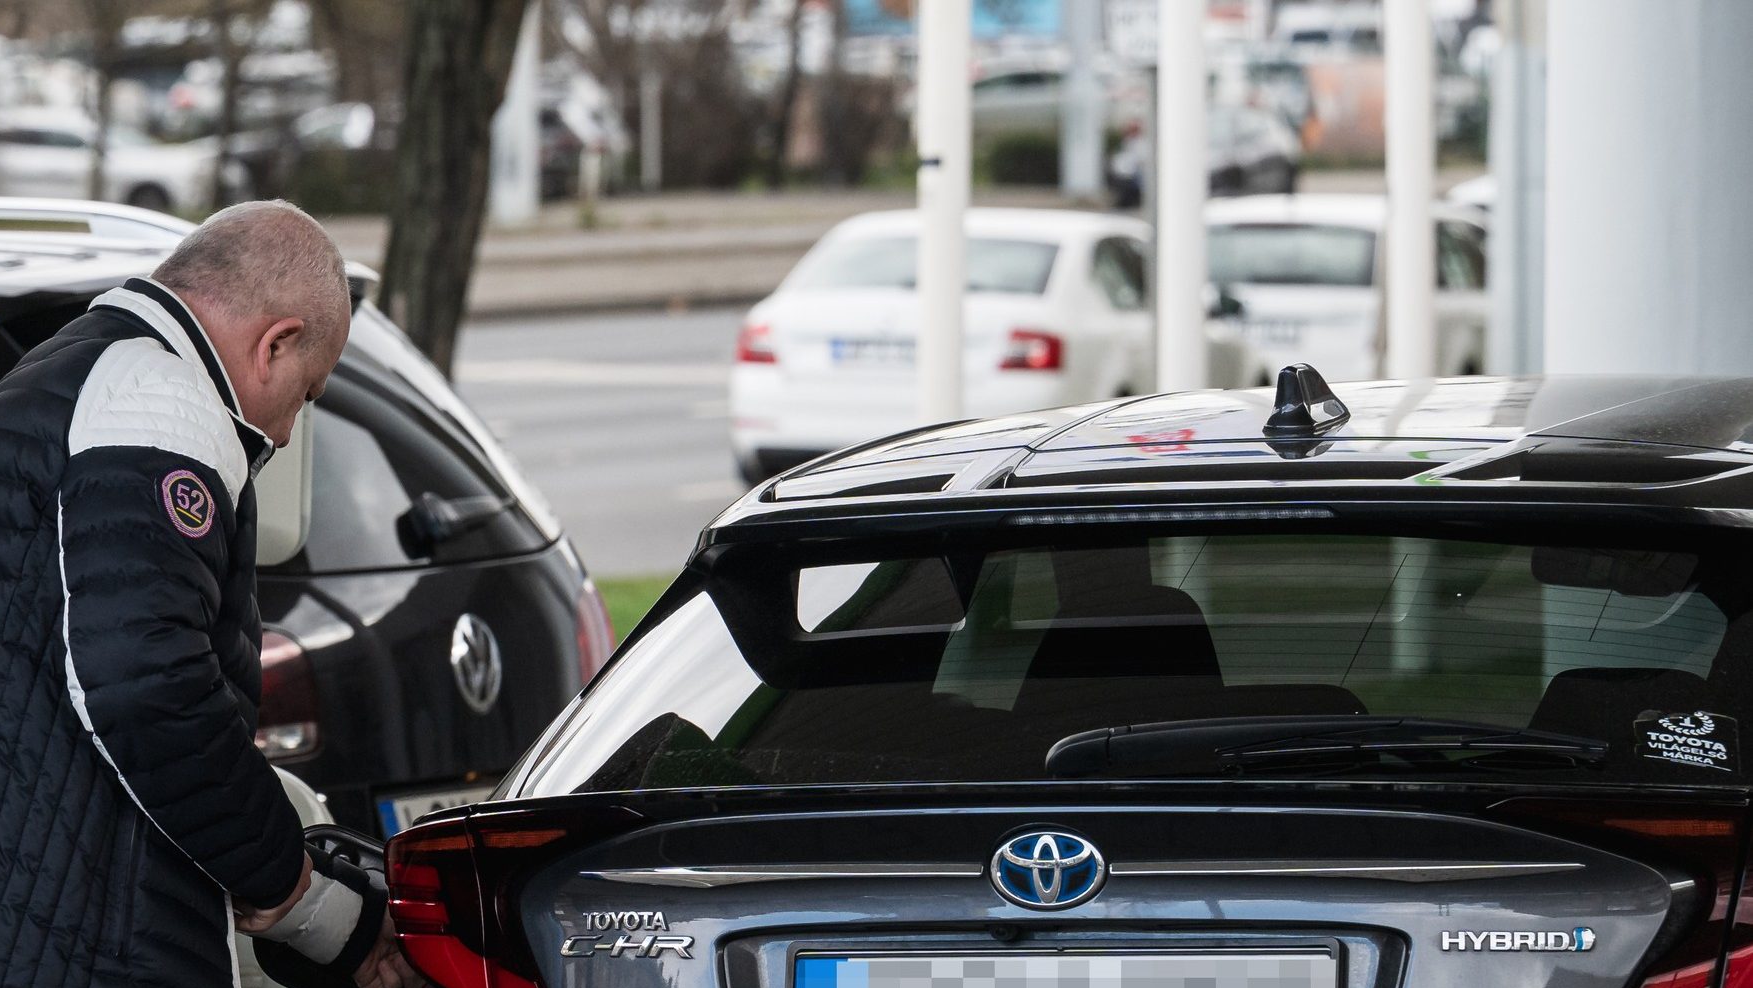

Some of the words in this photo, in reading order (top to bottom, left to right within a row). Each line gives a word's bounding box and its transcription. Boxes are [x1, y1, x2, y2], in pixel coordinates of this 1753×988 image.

[176, 484, 205, 519] 52
[1647, 731, 1727, 752] TOYOTA
[1648, 741, 1727, 760] VILÁGELSŐ
[1662, 751, 1714, 765] MÁRKA
[582, 910, 669, 931] TOYOTA
[560, 934, 696, 959] C-HR
[1441, 931, 1571, 951] HYBRID
